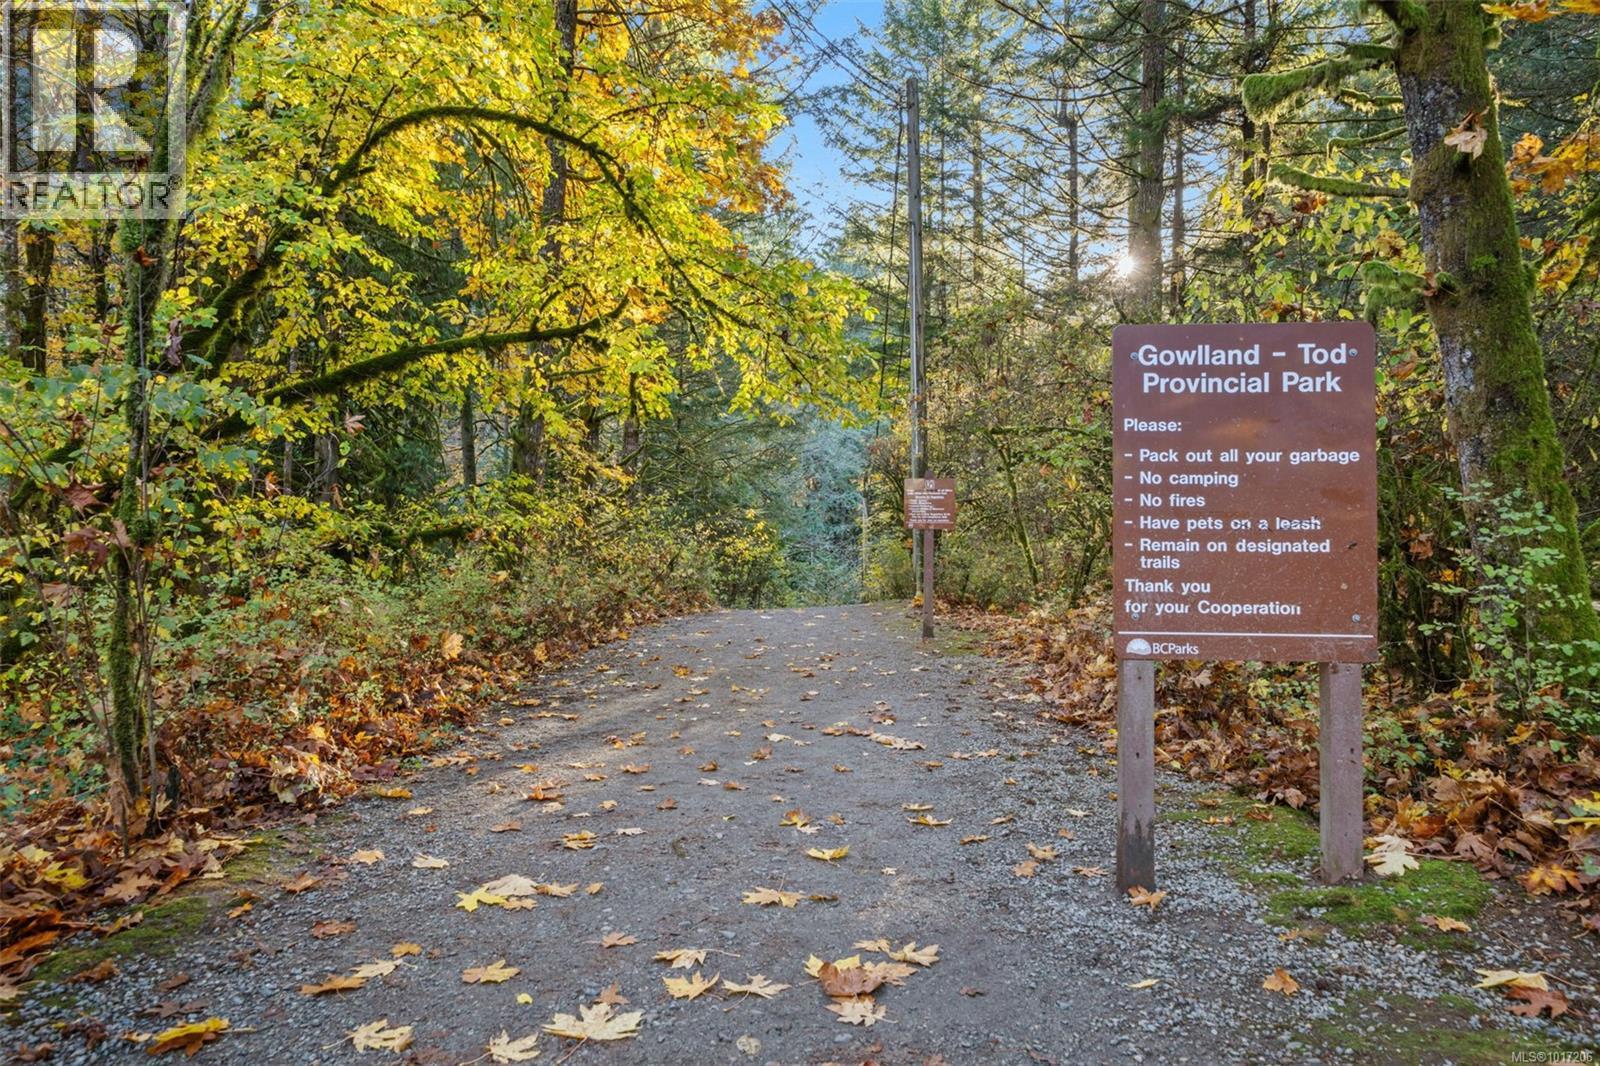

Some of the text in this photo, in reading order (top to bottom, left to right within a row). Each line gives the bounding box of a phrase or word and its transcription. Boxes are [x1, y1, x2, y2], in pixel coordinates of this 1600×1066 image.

[1137, 344, 1260, 366] Gowlland
[1297, 343, 1347, 365] Tod
[1143, 371, 1342, 394] Provincial Park
[1123, 418, 1182, 432] Please:
[1139, 448, 1179, 463] Pack
[1185, 449, 1213, 463] out
[1219, 449, 1239, 463] all
[1246, 452, 1283, 465] your
[1289, 448, 1361, 466] garbage
[1139, 471, 1163, 485] No
[1169, 472, 1239, 488] camping
[1139, 493, 1163, 507] No
[1169, 493, 1206, 507] fires
[1139, 515, 1180, 530] Have
[1187, 517, 1224, 532] pets
[1230, 519, 1252, 530] on
[1258, 519, 1269, 530] a
[1275, 516, 1322, 530] leash
[1139, 537, 1200, 552] Remain
[1206, 541, 1228, 552] on
[1235, 538, 1331, 555] designated
[1140, 554, 1181, 569] trails
[1124, 578, 1211, 595] Thank you
[1124, 599, 1302, 617] for your Cooperation
[1151, 642, 1200, 656] BCParks
